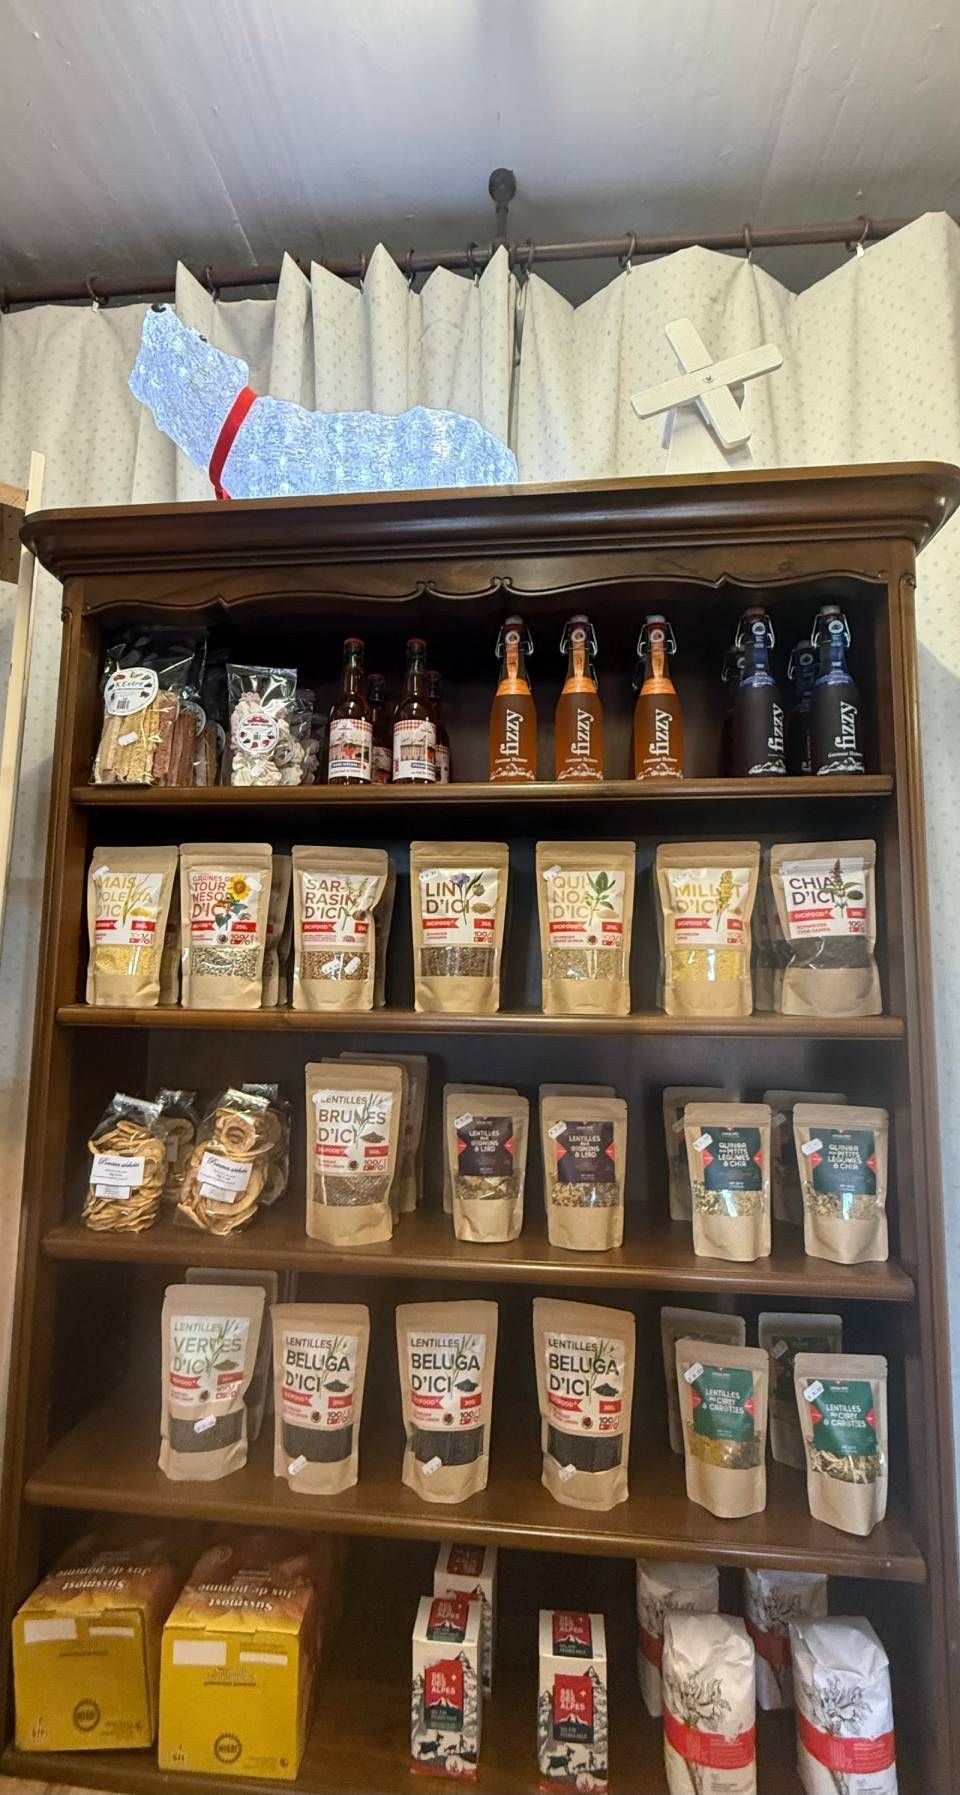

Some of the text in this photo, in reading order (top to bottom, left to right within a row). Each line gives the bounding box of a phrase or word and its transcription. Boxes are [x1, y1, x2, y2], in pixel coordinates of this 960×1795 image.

[500, 709, 524, 756] fizzy
[571, 709, 594, 755] fizzy
[649, 709, 673, 755] fizzy
[768, 703, 785, 752] fizzy
[834, 701, 858, 750] fizzy
[192, 882, 227, 892] TOUR
[426, 882, 456, 897] LIN
[788, 876, 836, 890] CHIA
[304, 891, 358, 906] RASIN
[792, 888, 836, 906] D'ICI
[304, 906, 343, 919] D'ICI
[426, 899, 470, 914] D'ICI
[319, 1109, 387, 1125] BRUNES
[318, 1127, 358, 1144] D'ICI
[285, 1336, 334, 1349] LENTILLES
[410, 1338, 460, 1348] LENTILLES
[548, 1338, 598, 1352] LENTILLES
[285, 1349, 351, 1372] BELUGA
[411, 1353, 480, 1371] BELUGA
[549, 1353, 620, 1376] BELUGA
[286, 1370, 321, 1392] D'ICI
[411, 1374, 452, 1393] D'ICI
[550, 1374, 590, 1397] D'ICI
[705, 1388, 740, 1400] LENTILLES
[826, 1404, 862, 1413] LENTILLES
[272, 1587, 297, 1599] Jus
